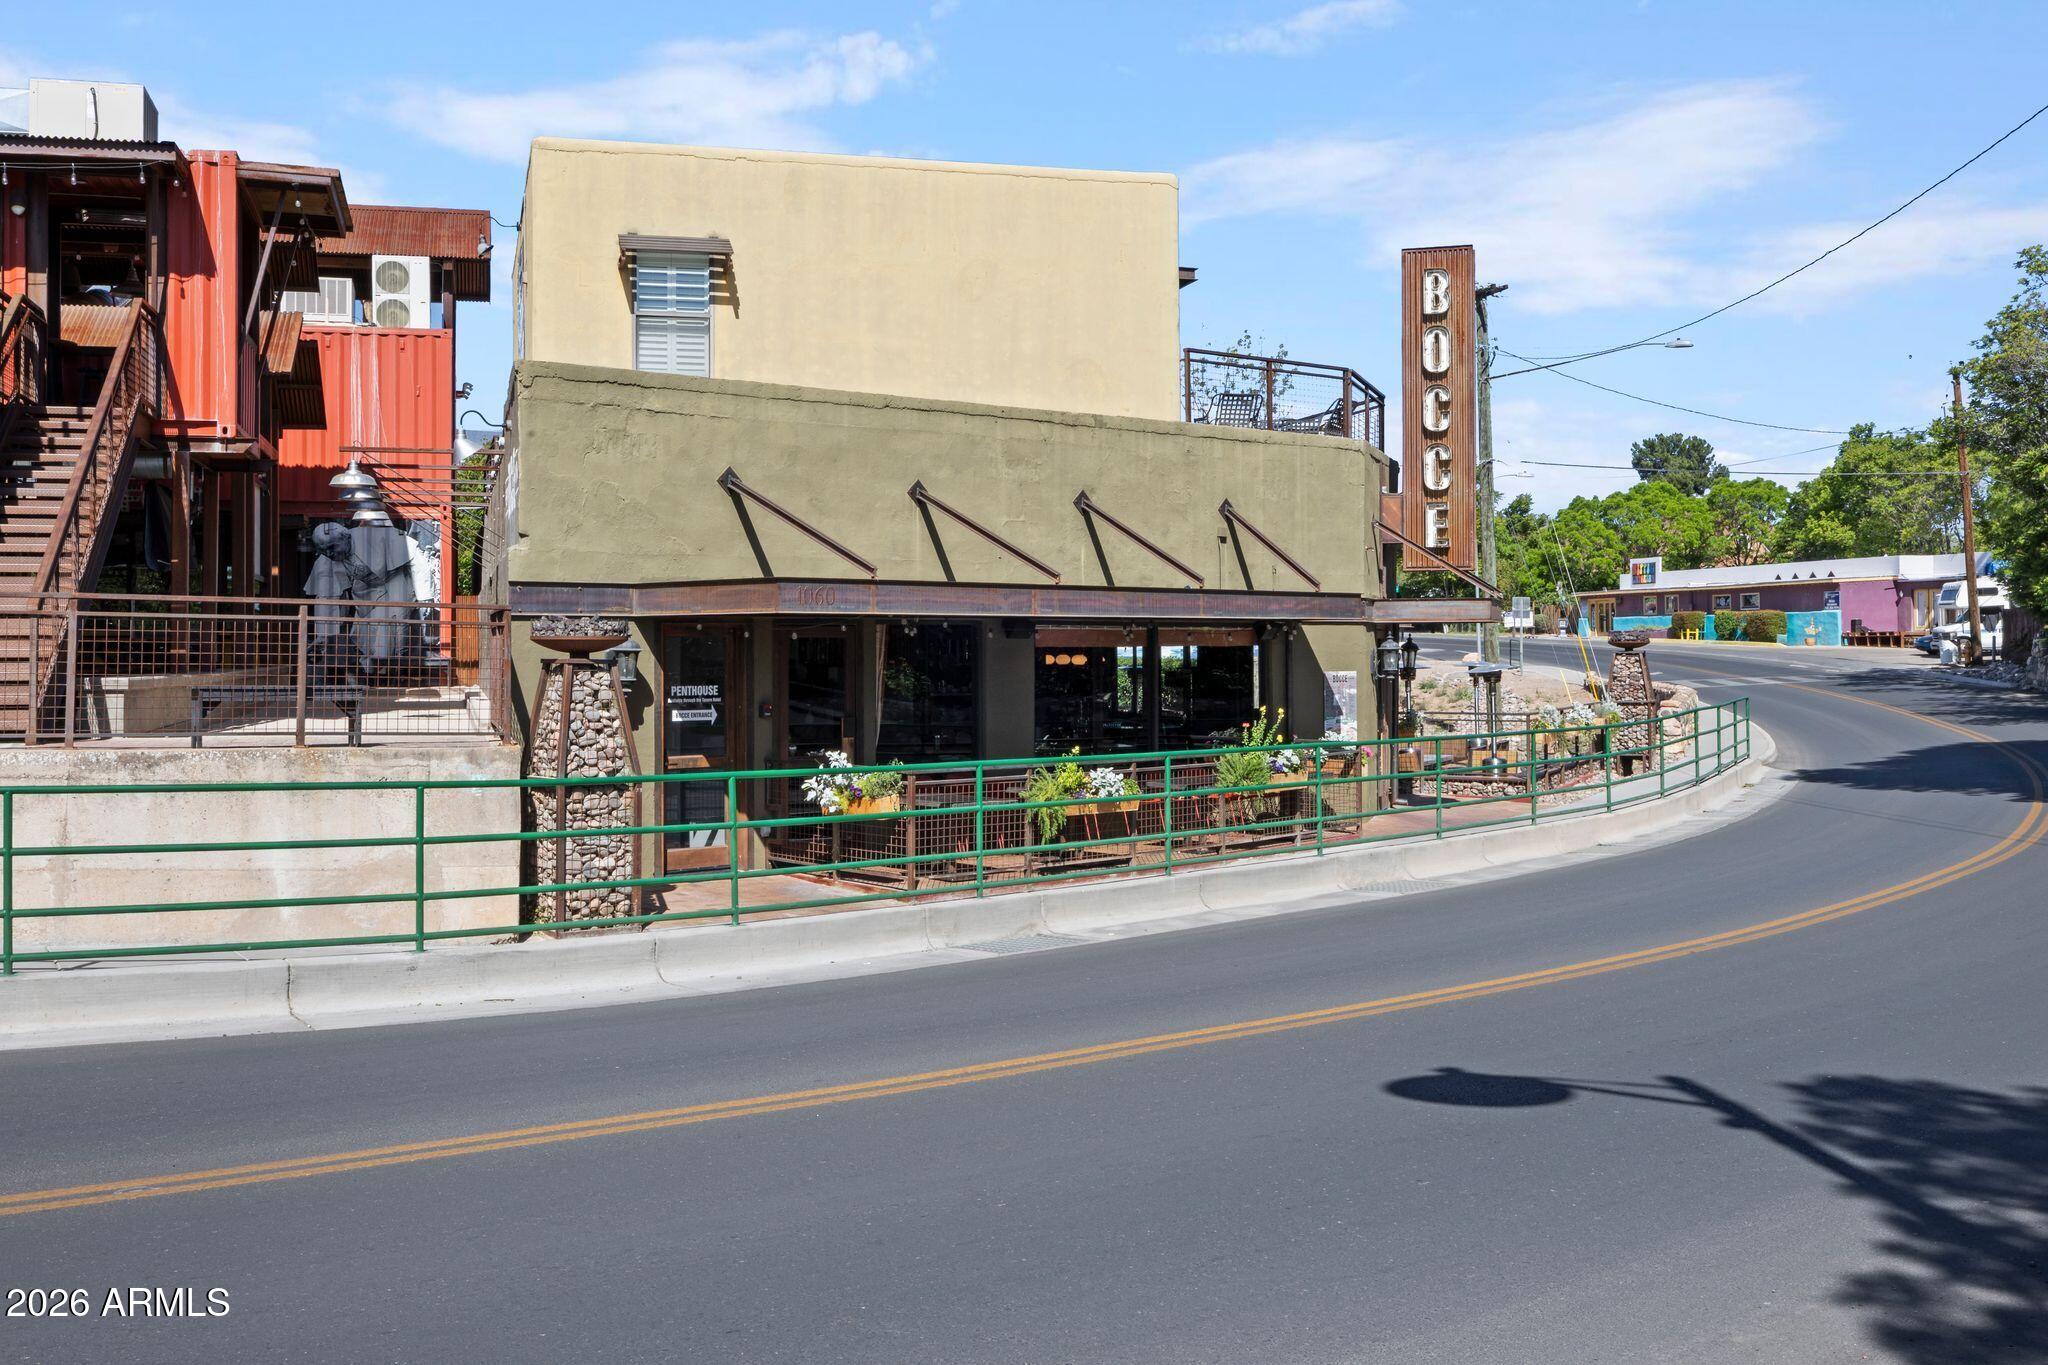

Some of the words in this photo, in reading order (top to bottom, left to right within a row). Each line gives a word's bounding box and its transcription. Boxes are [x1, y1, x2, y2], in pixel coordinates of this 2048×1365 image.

[1423, 268, 1451, 549] BOCCE
[796, 585, 836, 606] 1060
[671, 685, 719, 696] PENTHOUSE
